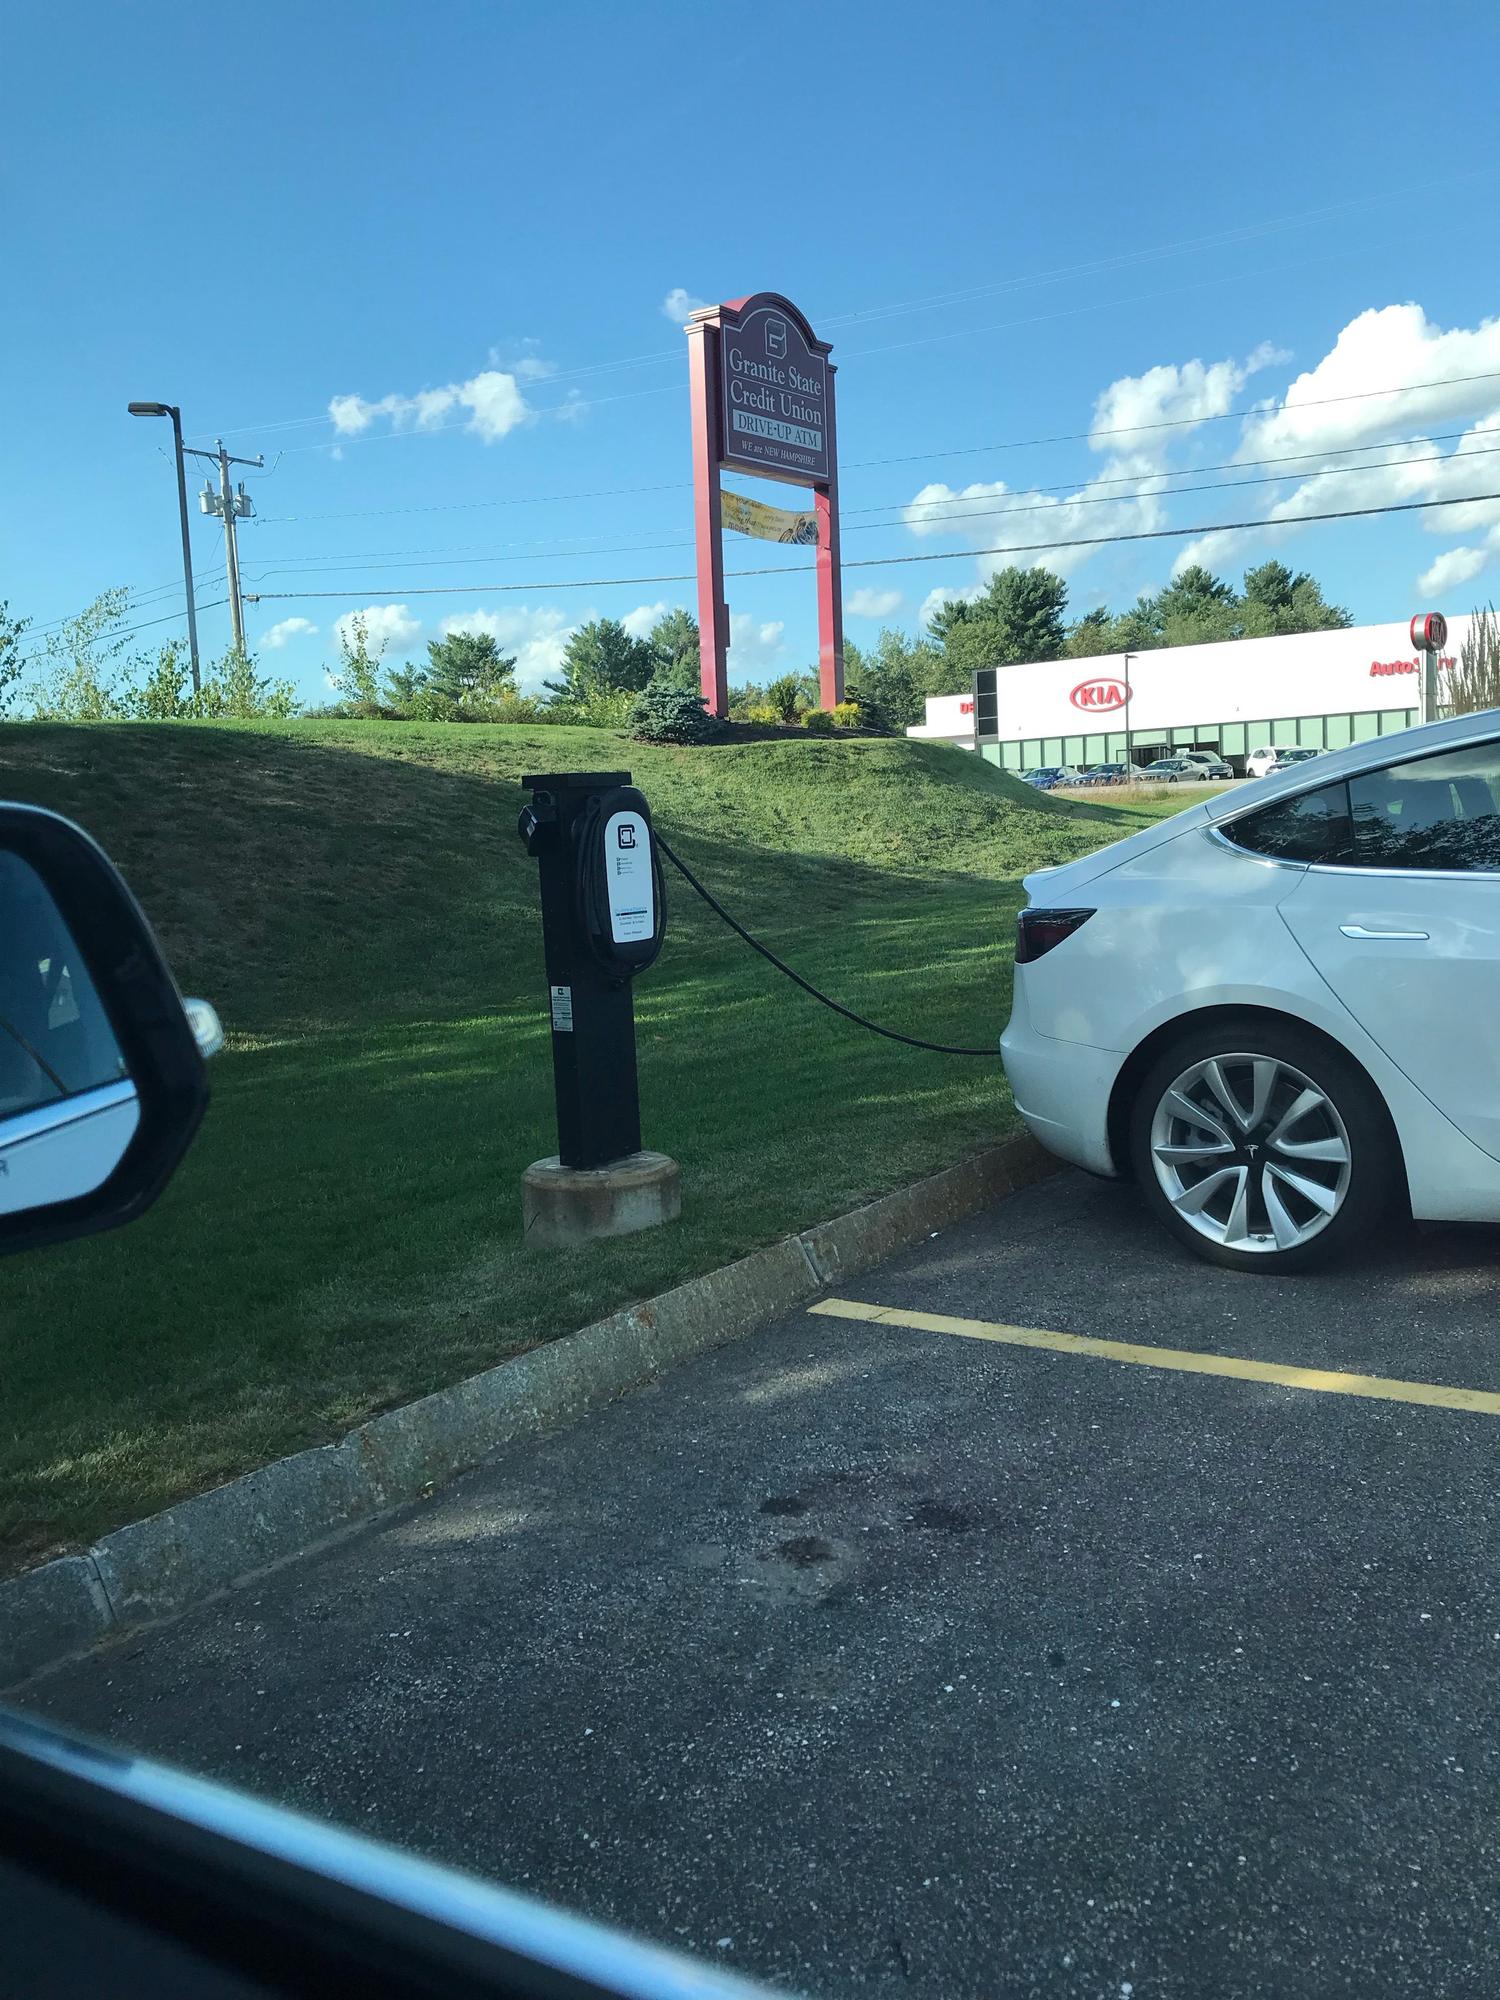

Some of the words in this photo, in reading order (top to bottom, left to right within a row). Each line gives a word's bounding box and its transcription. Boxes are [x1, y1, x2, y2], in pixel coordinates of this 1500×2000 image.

[730, 348, 785, 385] Granite
[788, 366, 821, 395] State
[730, 380, 775, 412] Credit
[779, 393, 822, 425] Union
[741, 440, 753, 450] WE
[753, 445, 763, 453] are
[764, 446, 779, 457] NEW
[780, 449, 816, 465] HAMPSHIRE
[794, 433, 818, 447] ATM
[1081, 685, 1124, 706] KIA
